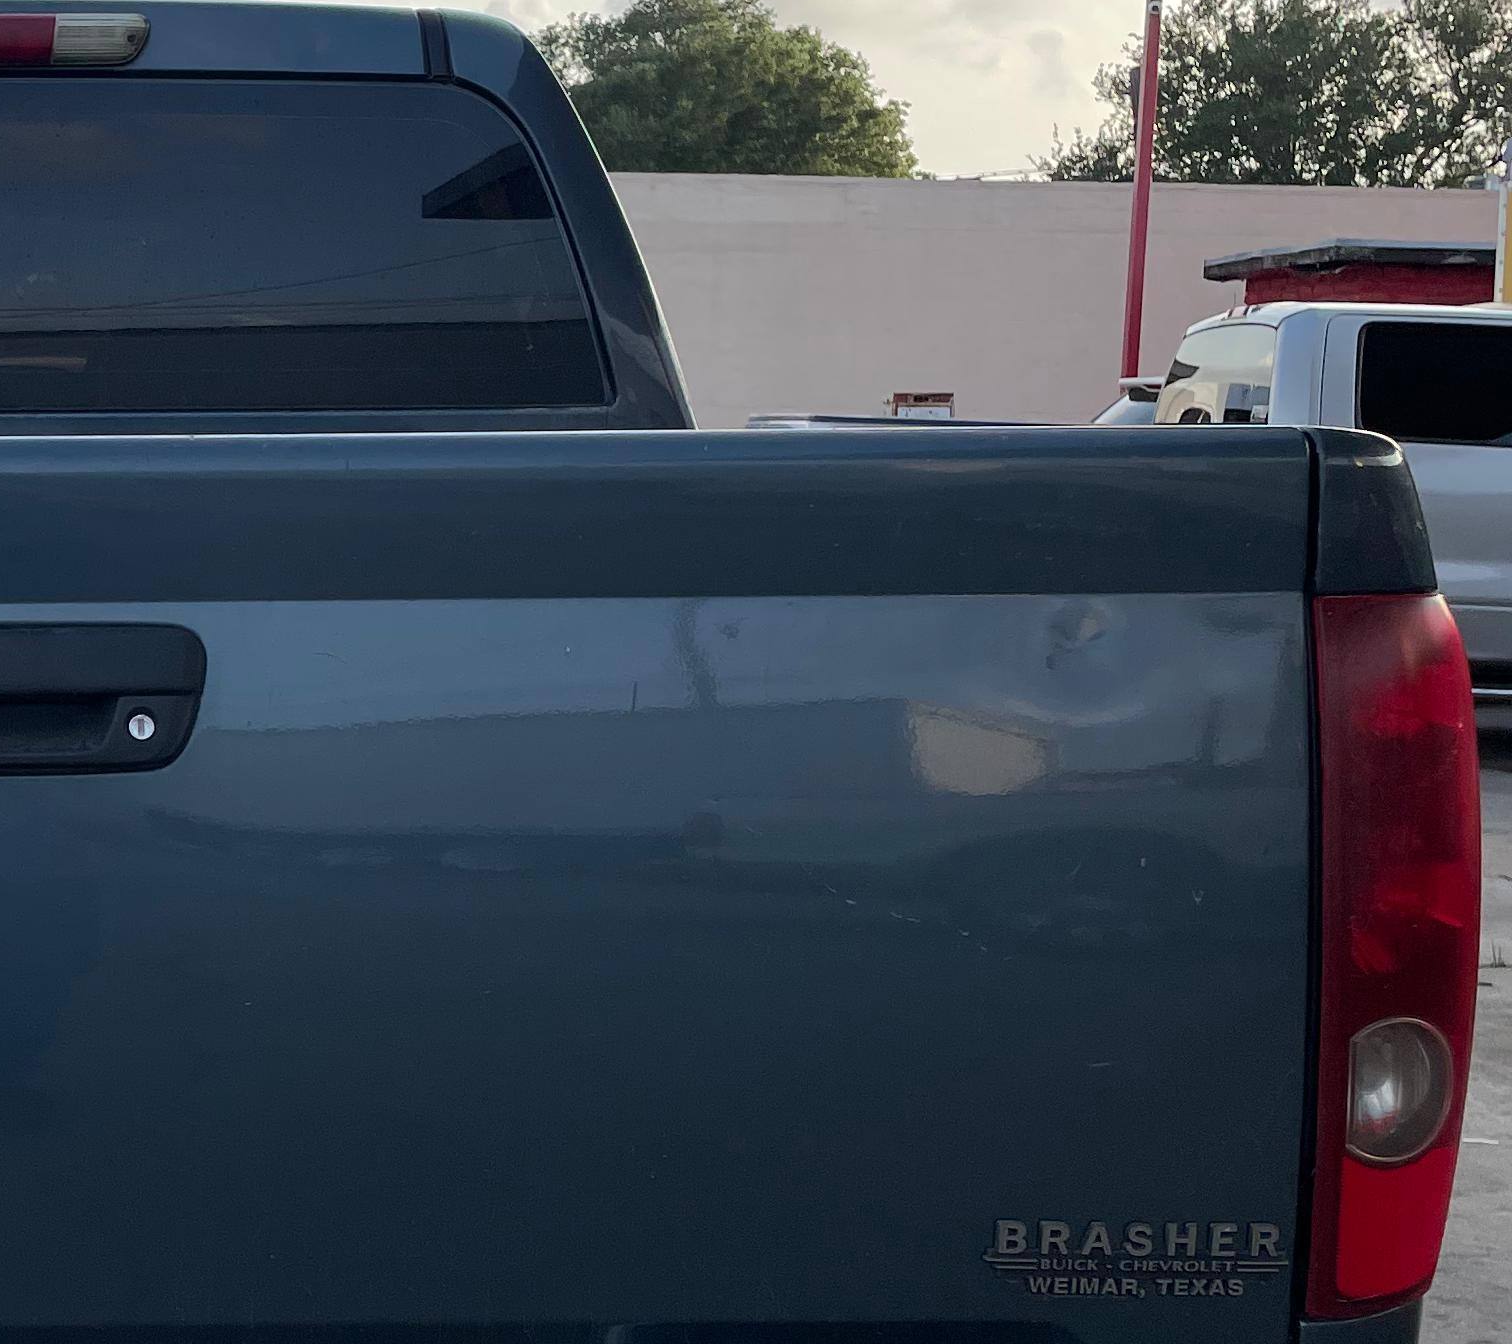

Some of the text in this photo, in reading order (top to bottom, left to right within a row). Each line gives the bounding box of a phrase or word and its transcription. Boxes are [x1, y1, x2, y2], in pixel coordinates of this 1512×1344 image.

[995, 1219, 1281, 1257] BRASHER
[1039, 1258, 1236, 1273] BUICK CHEVROLET
[1028, 1276, 1245, 1298] WEIMAR, TEXAS
